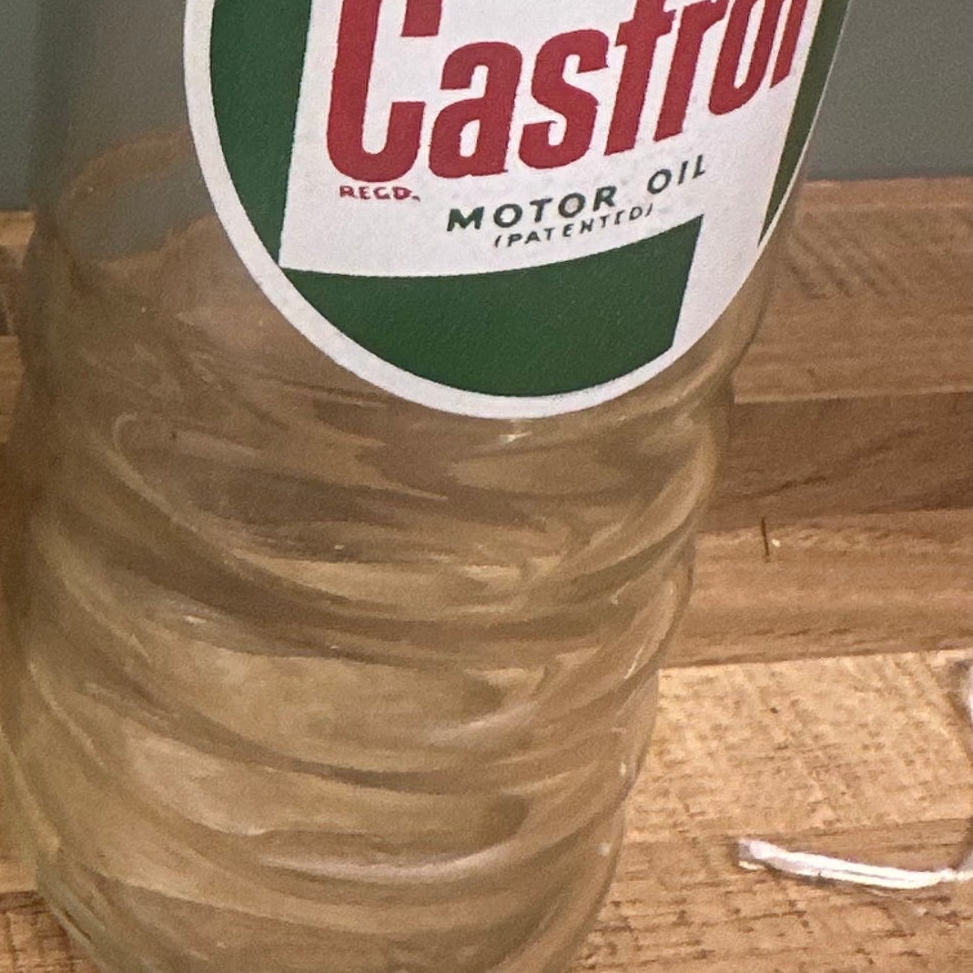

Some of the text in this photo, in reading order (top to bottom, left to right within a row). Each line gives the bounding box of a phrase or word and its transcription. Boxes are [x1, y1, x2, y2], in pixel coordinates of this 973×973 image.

[446, 154, 706, 233] MOTOR OIL
[494, 203, 654, 249] (PATENTED)
